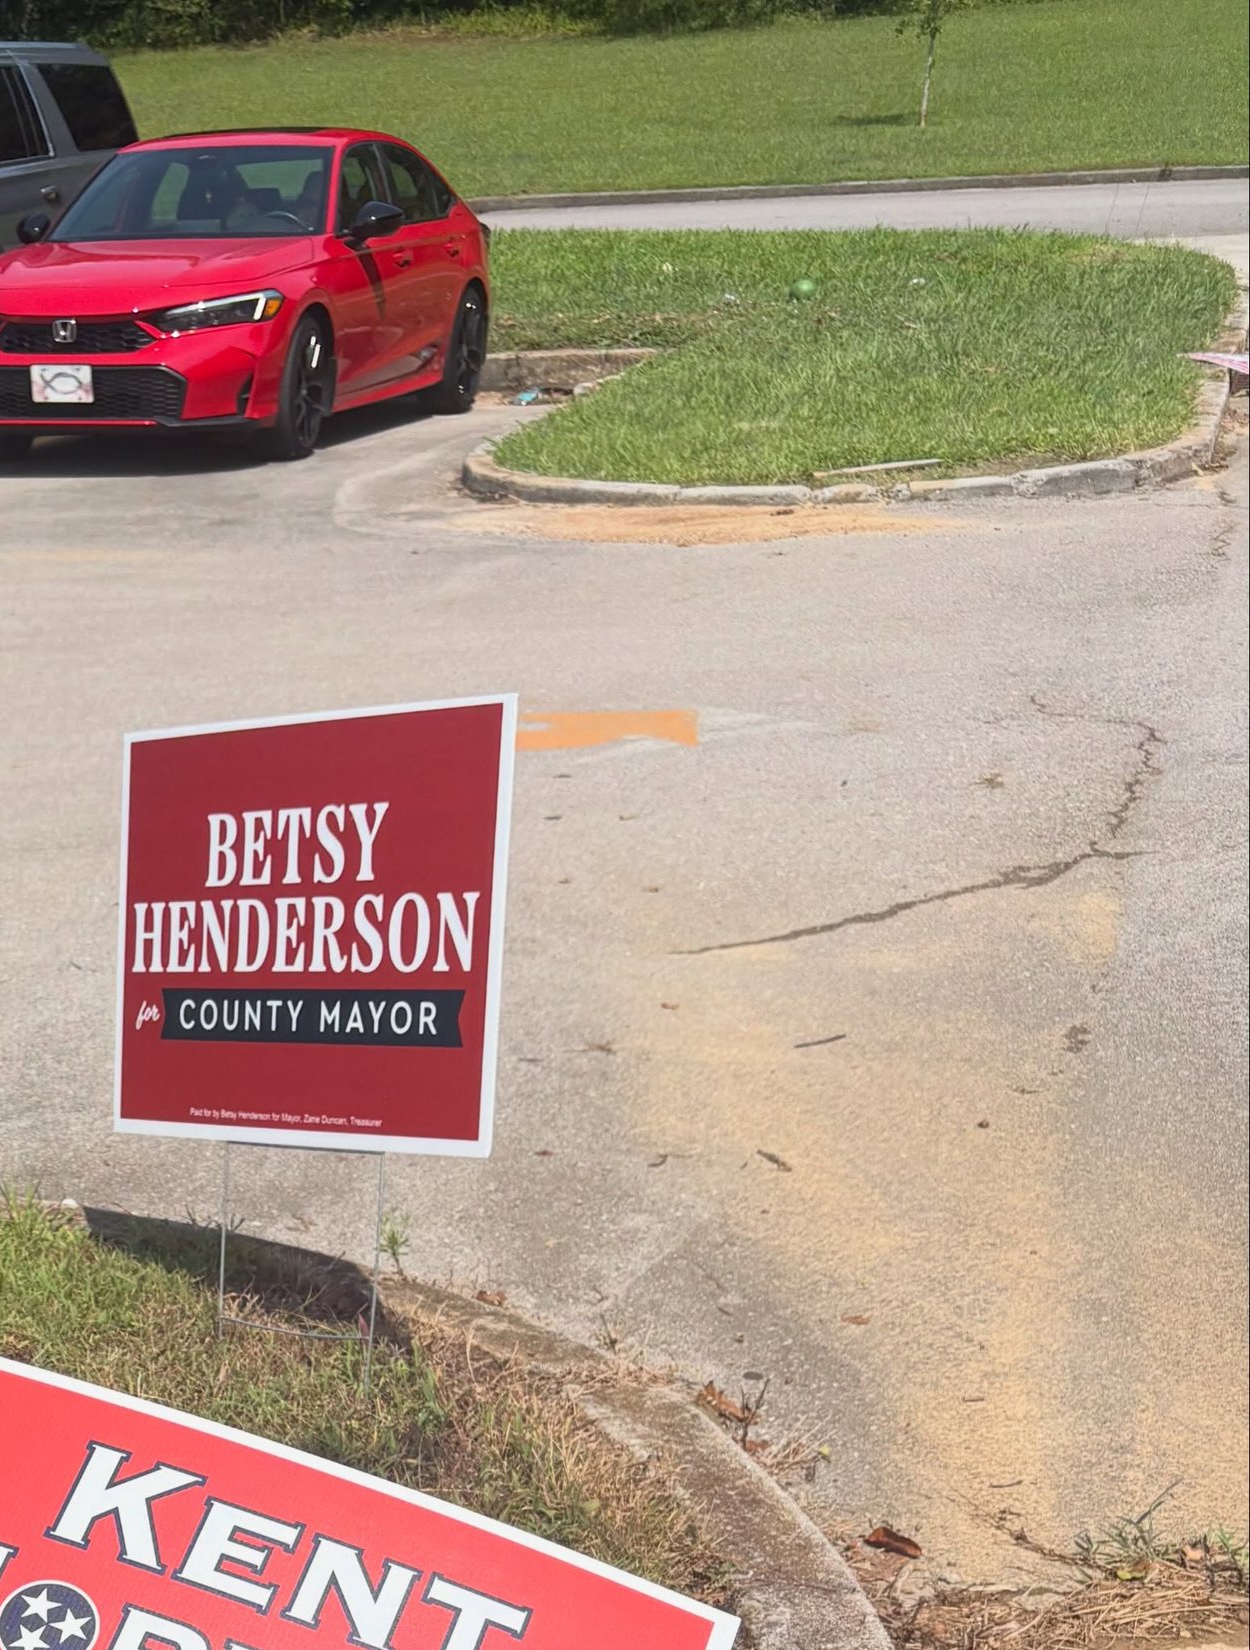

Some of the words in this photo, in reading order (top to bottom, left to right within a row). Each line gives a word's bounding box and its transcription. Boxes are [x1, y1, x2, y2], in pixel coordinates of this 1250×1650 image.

[205, 801, 390, 887] BETSY
[131, 891, 481, 974] HENDERSON
[136, 1001, 160, 1030] for
[179, 999, 304, 1031] COUNTY
[320, 1000, 438, 1036] MAYOR
[190, 1107, 203, 1117] Paid
[213, 1109, 219, 1119] by
[220, 1108, 237, 1120] Betsy
[238, 1110, 271, 1121] Henderson
[271, 1112, 280, 1121] for
[303, 1113, 320, 1124] Zane
[350, 1115, 383, 1127] Treasurer
